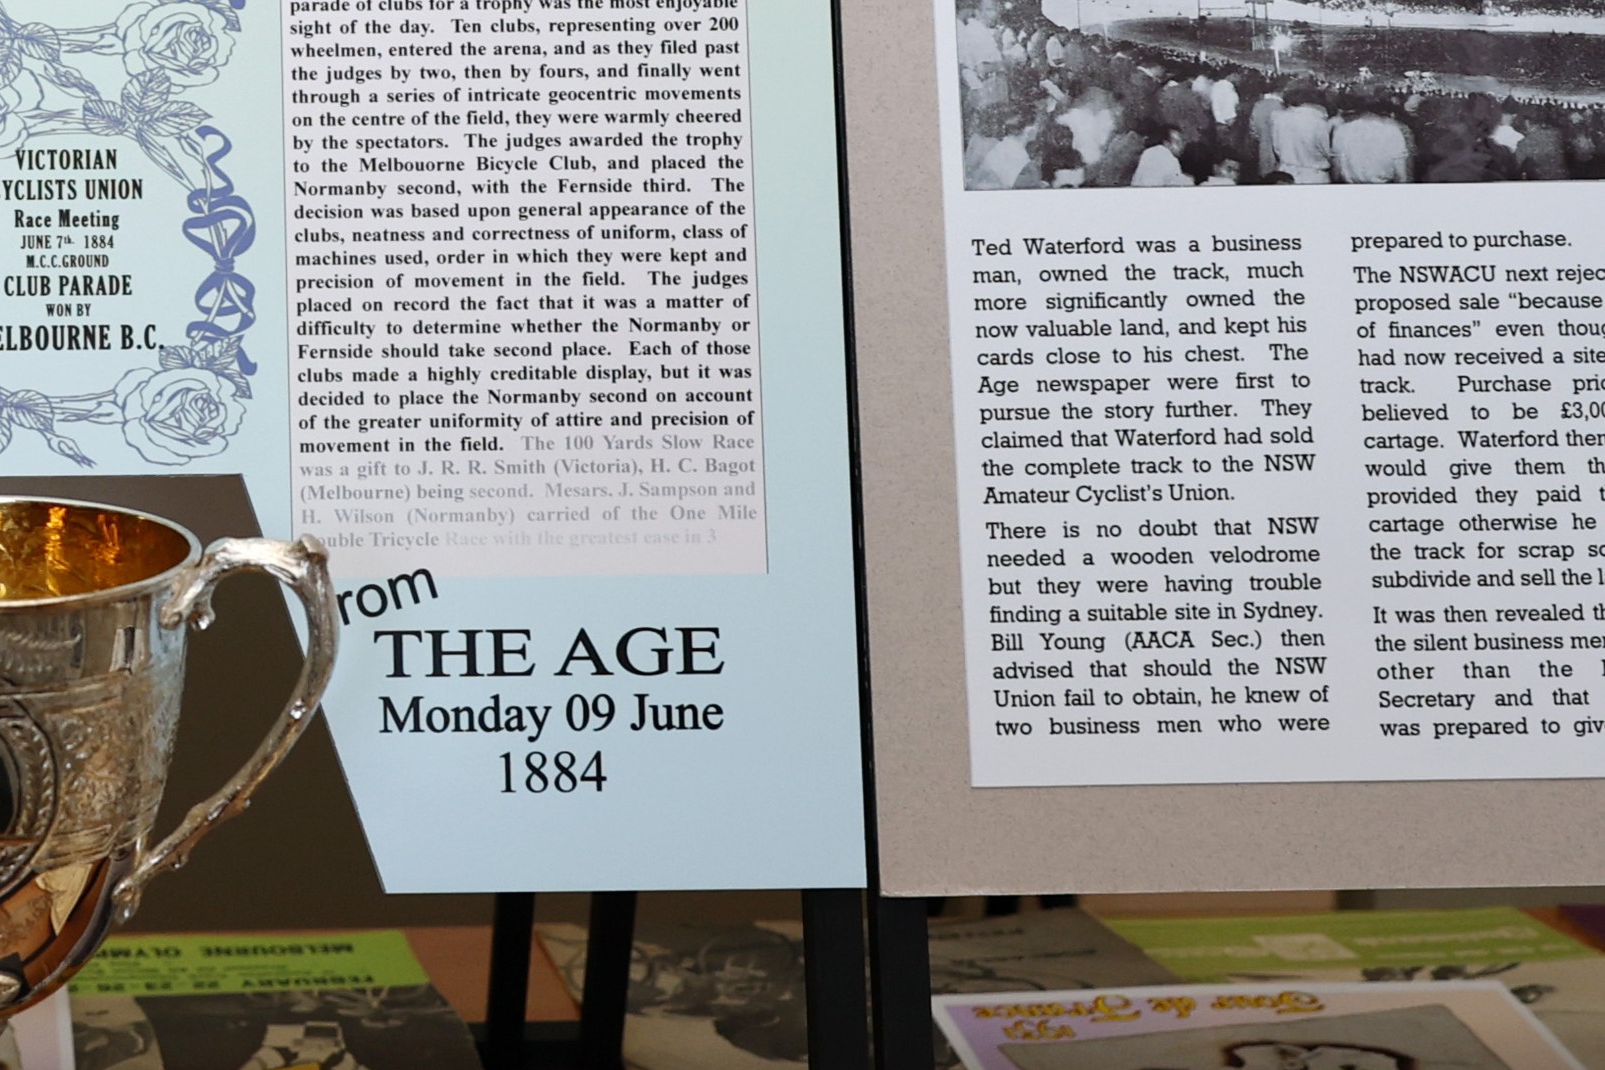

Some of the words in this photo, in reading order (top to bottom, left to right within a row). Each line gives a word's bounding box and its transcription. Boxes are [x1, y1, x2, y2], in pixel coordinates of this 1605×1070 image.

[289, 19, 331, 39] sight
[339, 18, 358, 35] of
[364, 18, 391, 35] the
[399, 18, 434, 39] day.
[450, 17, 481, 34] Ten
[490, 17, 540, 35] clubs,
[548, 16, 656, 38] representing
[663, 20, 701, 32] over
[709, 15, 739, 32] 200
[15, 147, 117, 172] VICTORIAN
[293, 160, 310, 174] to
[321, 157, 348, 174] the
[476, 155, 538, 176] Bicycle
[548, 154, 597, 172] Club,
[607, 154, 639, 171] and
[651, 153, 706, 175] placed
[717, 153, 744, 170] the
[85, 177, 143, 201] UNION
[13, 208, 51, 229] Race
[57, 207, 119, 232] Meeting
[20, 233, 52, 251] JUNE
[84, 233, 114, 250] 1884
[971, 237, 1013, 257] Ted
[1022, 235, 1126, 256] Waterford
[1136, 239, 1177, 254] was
[1188, 238, 1201, 254] a
[1212, 233, 1303, 253] business
[25, 253, 109, 269] M.C.C.GROUND
[3, 274, 51, 298] CLUB
[58, 273, 133, 297] PARADE
[45, 302, 72, 318] WON
[76, 302, 91, 318] BY
[120, 323, 165, 351] B.C.
[336, 567, 439, 625] rom
[373, 628, 536, 679] THE
[554, 625, 725, 678] AGE
[991, 632, 1024, 653] Bill
[1039, 631, 1106, 654] Young
[1124, 629, 1195, 653] (AACA
[1211, 629, 1262, 651] Sec.)
[1280, 627, 1326, 648] then
[379, 692, 553, 744] Monday
[566, 692, 616, 733] 09
[630, 692, 725, 732] June
[499, 749, 607, 795] 1884
